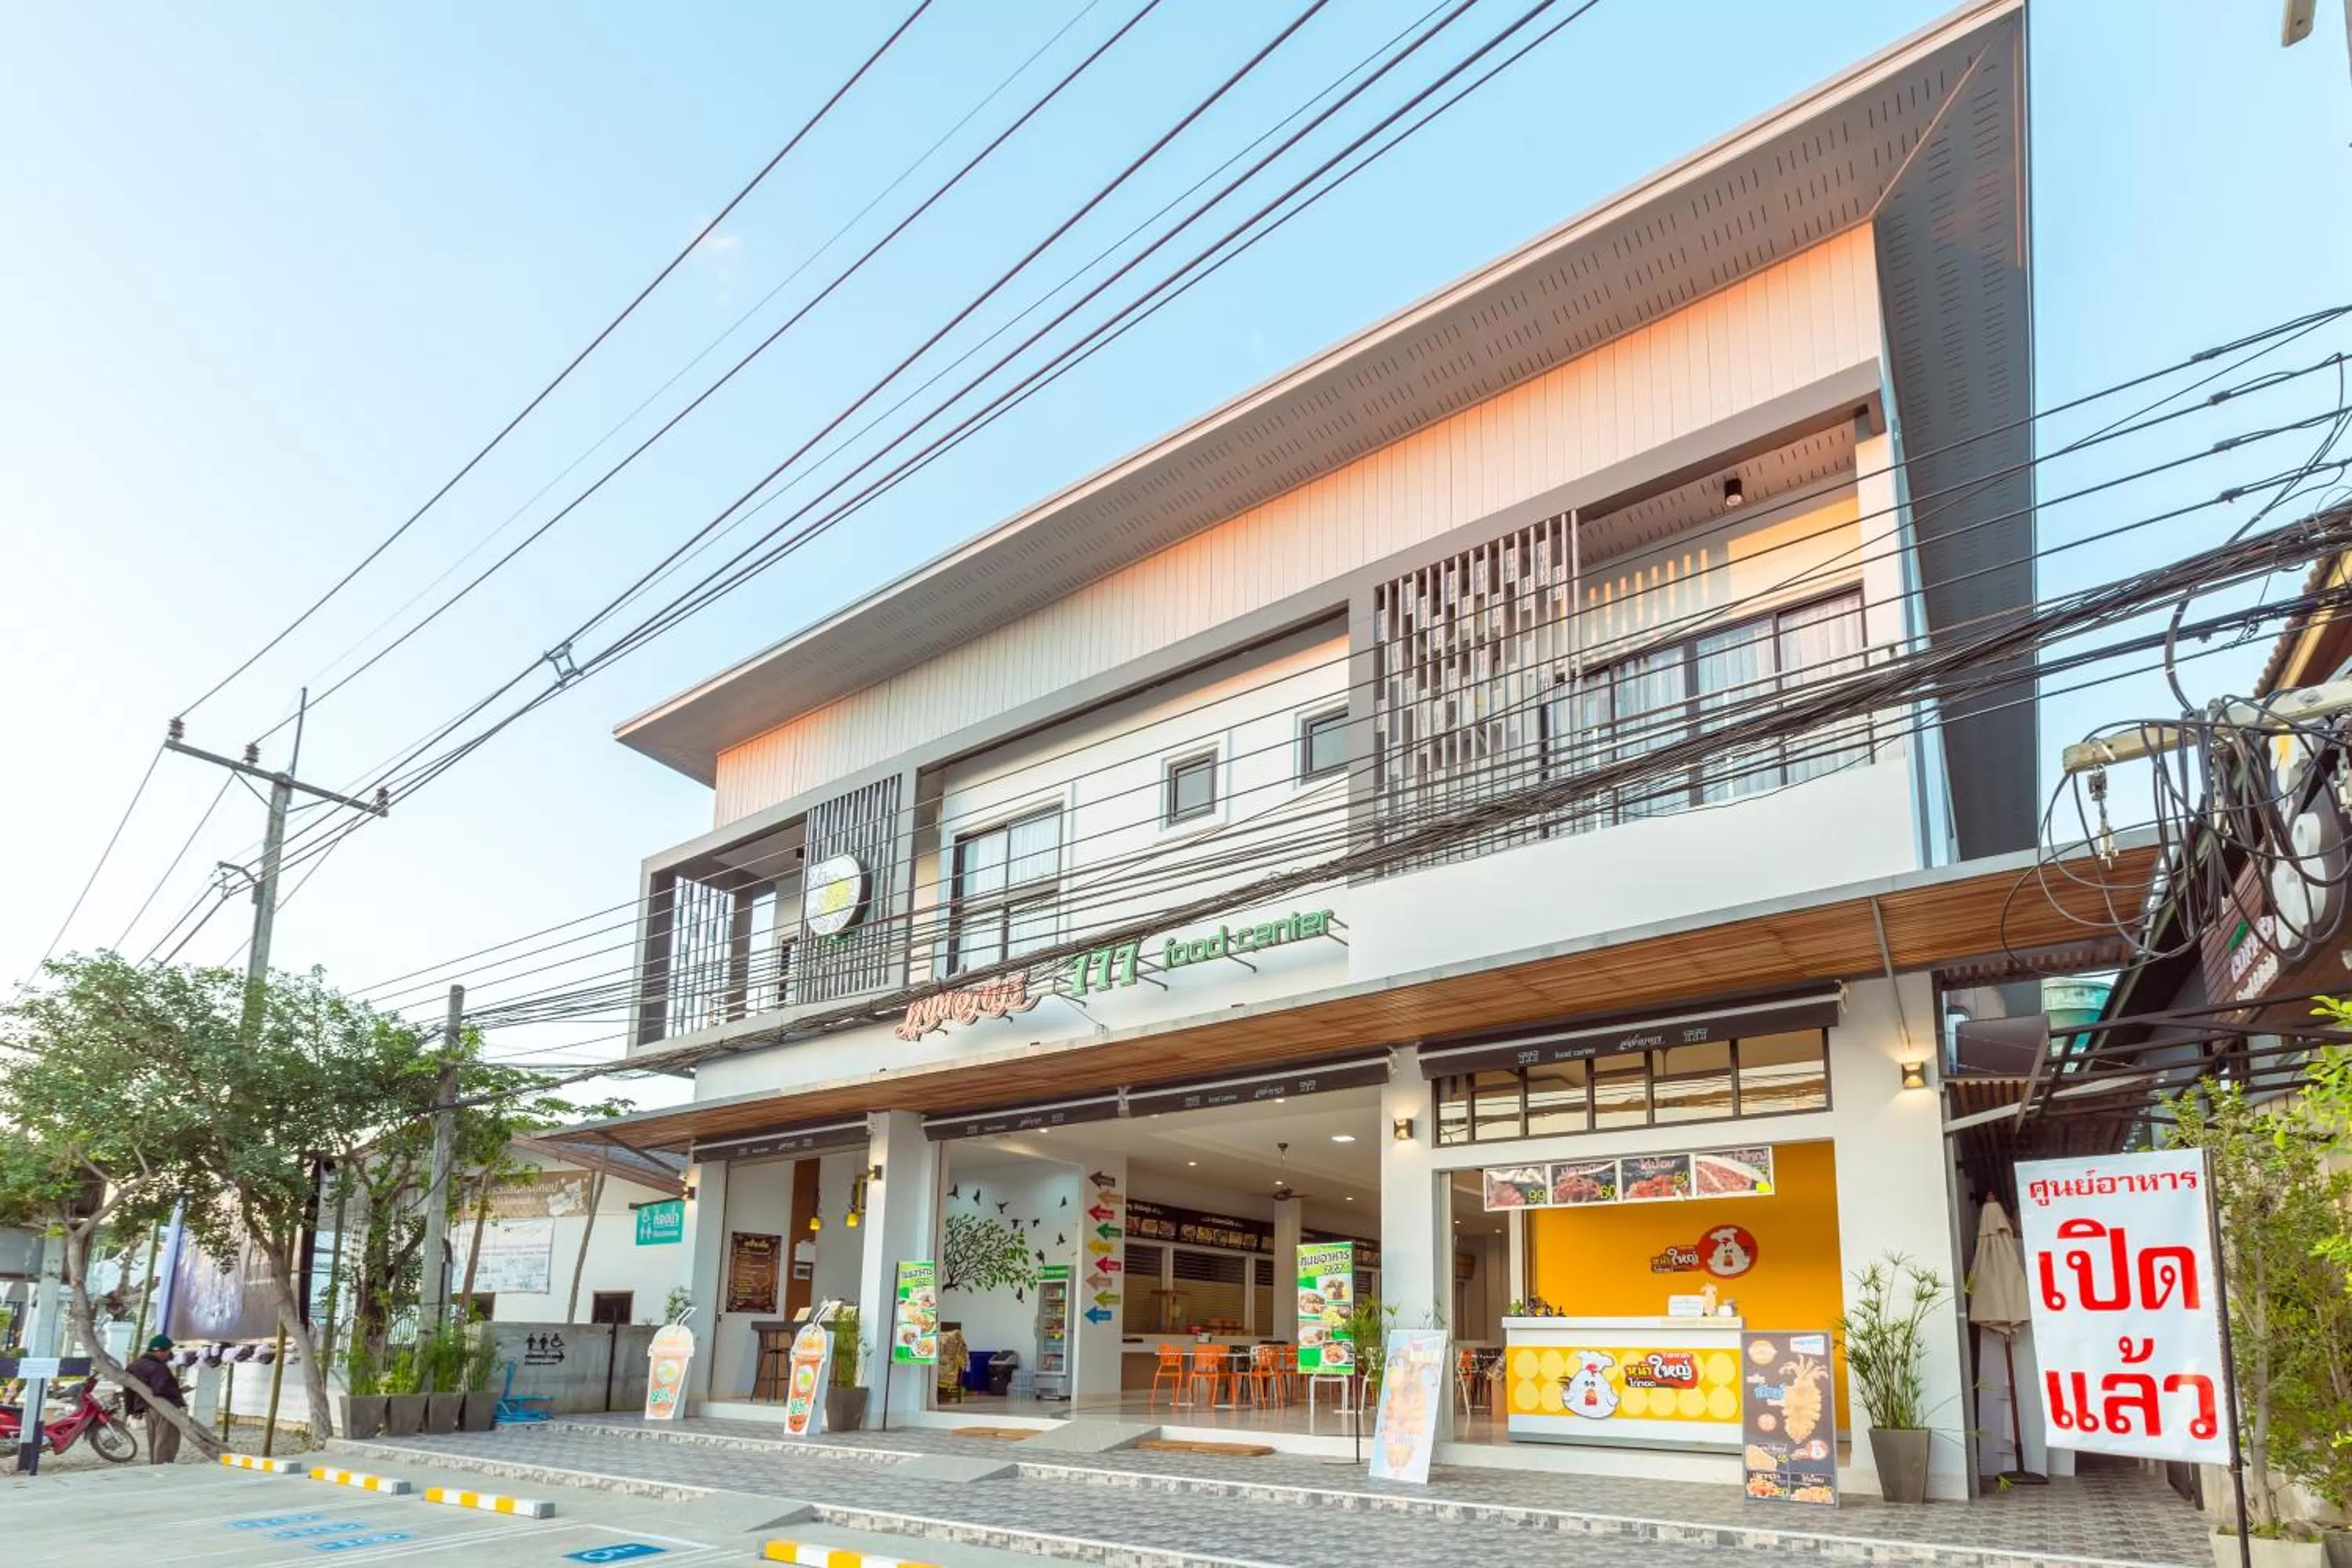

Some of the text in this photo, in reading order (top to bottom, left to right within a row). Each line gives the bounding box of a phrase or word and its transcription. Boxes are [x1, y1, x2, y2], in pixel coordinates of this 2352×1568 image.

[1069, 941, 1139, 997] 777
[1163, 908, 1334, 970] food center
[2029, 1170, 2198, 1206] ศูนย์อาหาร
[2038, 1218, 2201, 1311] เปิด
[2045, 1336, 2218, 1439] แล้ว
